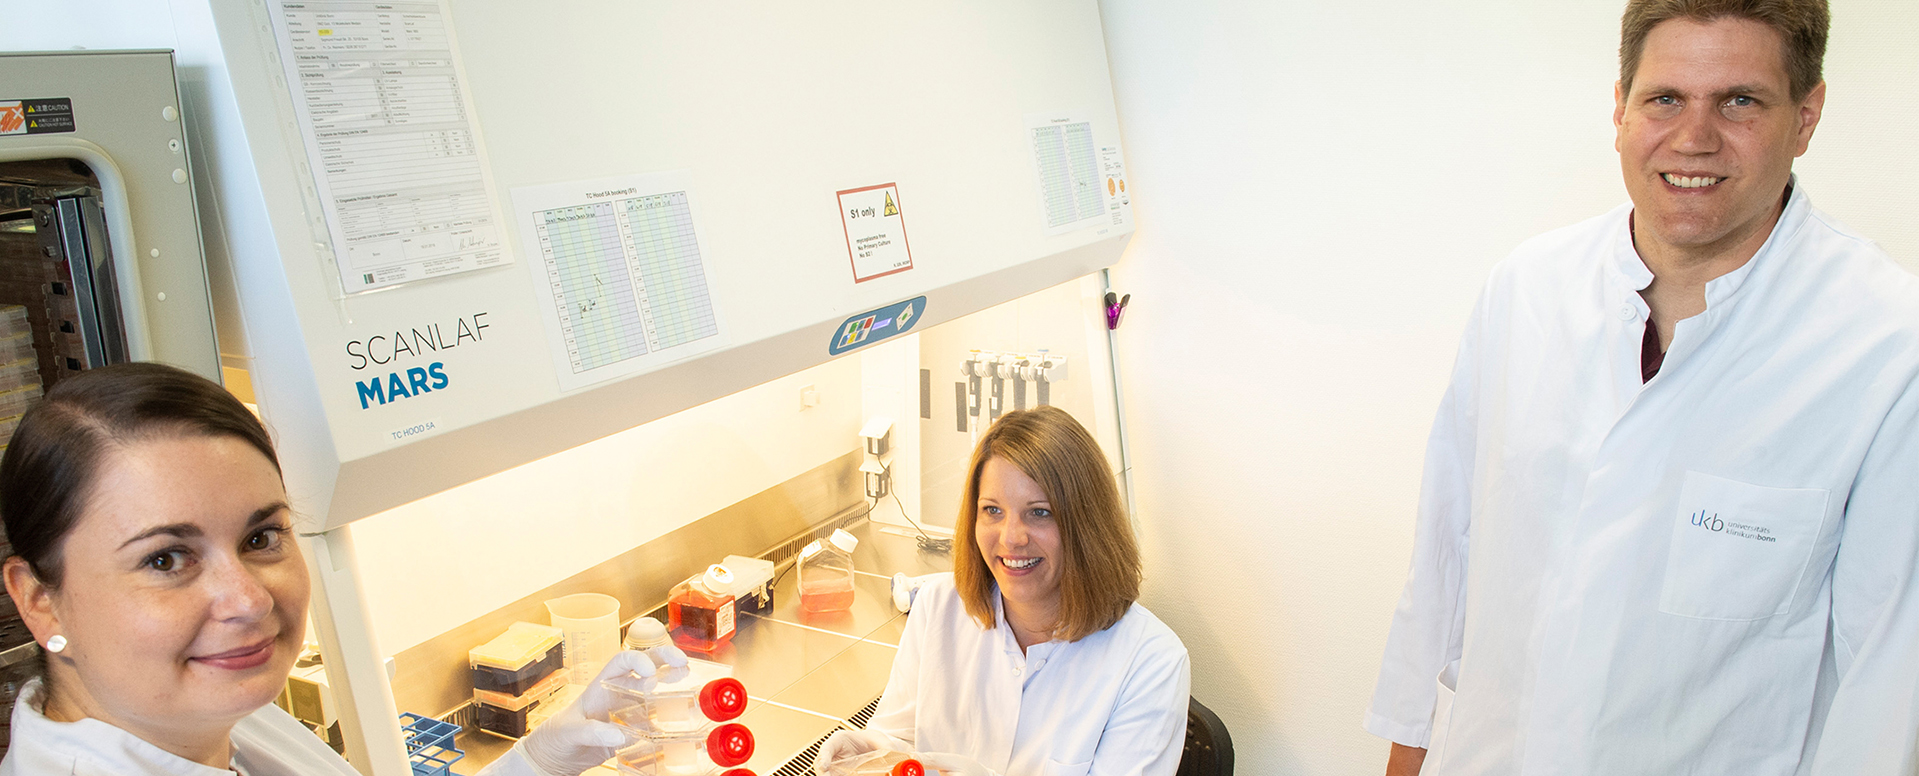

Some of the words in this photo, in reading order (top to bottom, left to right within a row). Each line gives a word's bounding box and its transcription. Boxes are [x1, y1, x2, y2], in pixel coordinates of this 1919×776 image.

[850, 208, 860, 219] S1
[861, 206, 876, 218] only
[856, 235, 878, 244] mycoplasma
[346, 312, 490, 370] SCANLAF
[355, 362, 449, 410] MARS
[392, 430, 402, 440] TC
[403, 424, 425, 437] HOOD
[425, 421, 436, 431] 5A
[1727, 521, 1771, 534] universitäts
